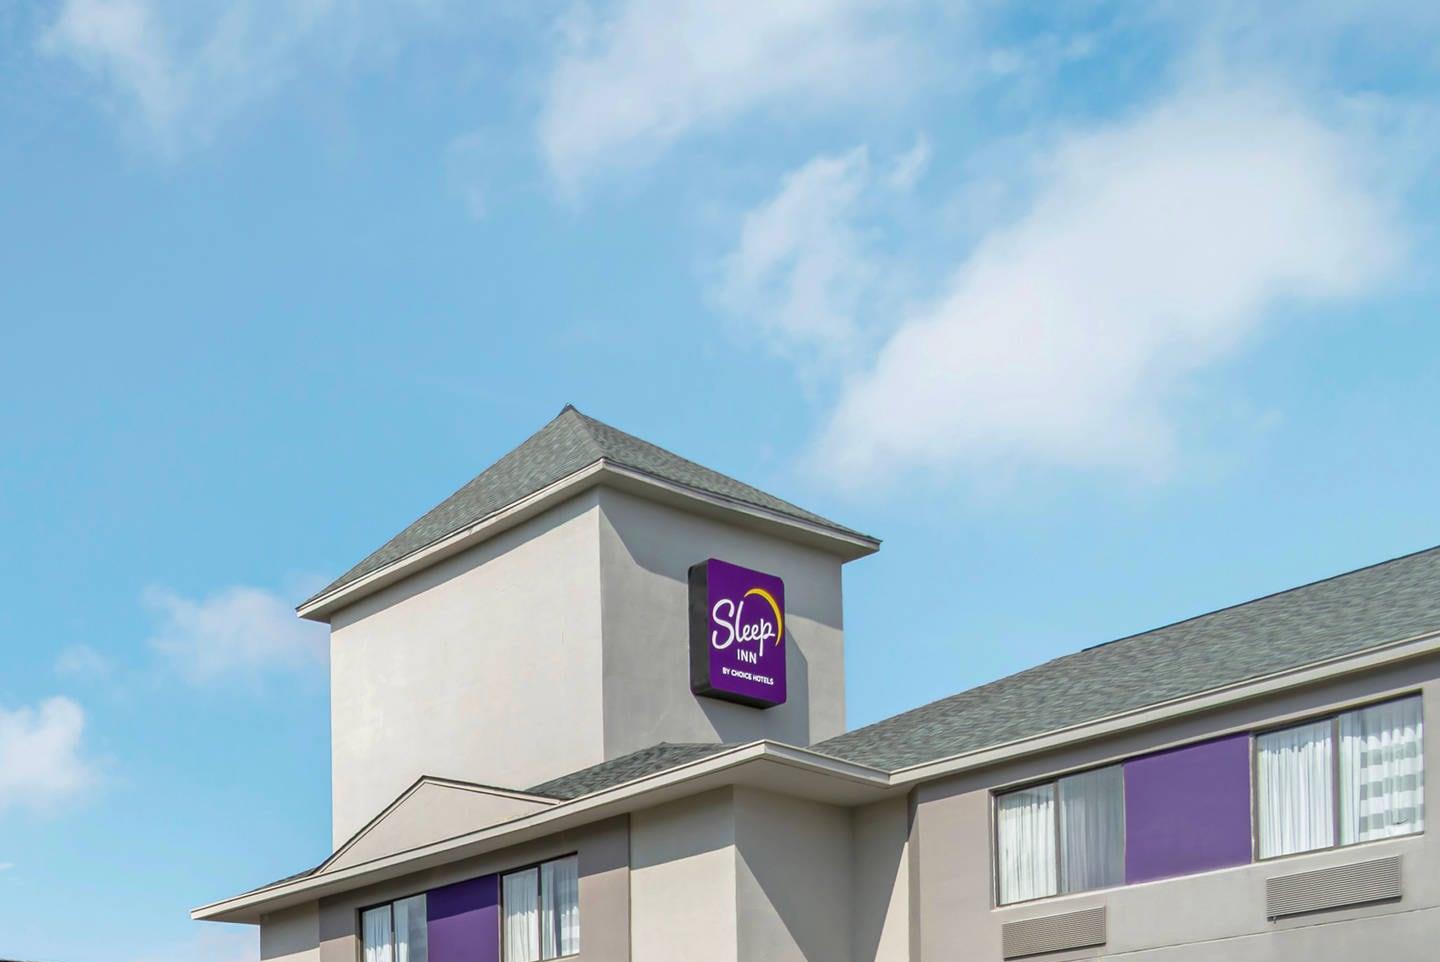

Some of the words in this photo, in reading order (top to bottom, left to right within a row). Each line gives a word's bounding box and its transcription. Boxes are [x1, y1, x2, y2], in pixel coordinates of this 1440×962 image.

[712, 599, 776, 657] Sleep
[737, 648, 757, 665] INN
[722, 666, 731, 675] BY
[730, 669, 753, 681] CHOICE
[752, 674, 775, 686] HOTELS
